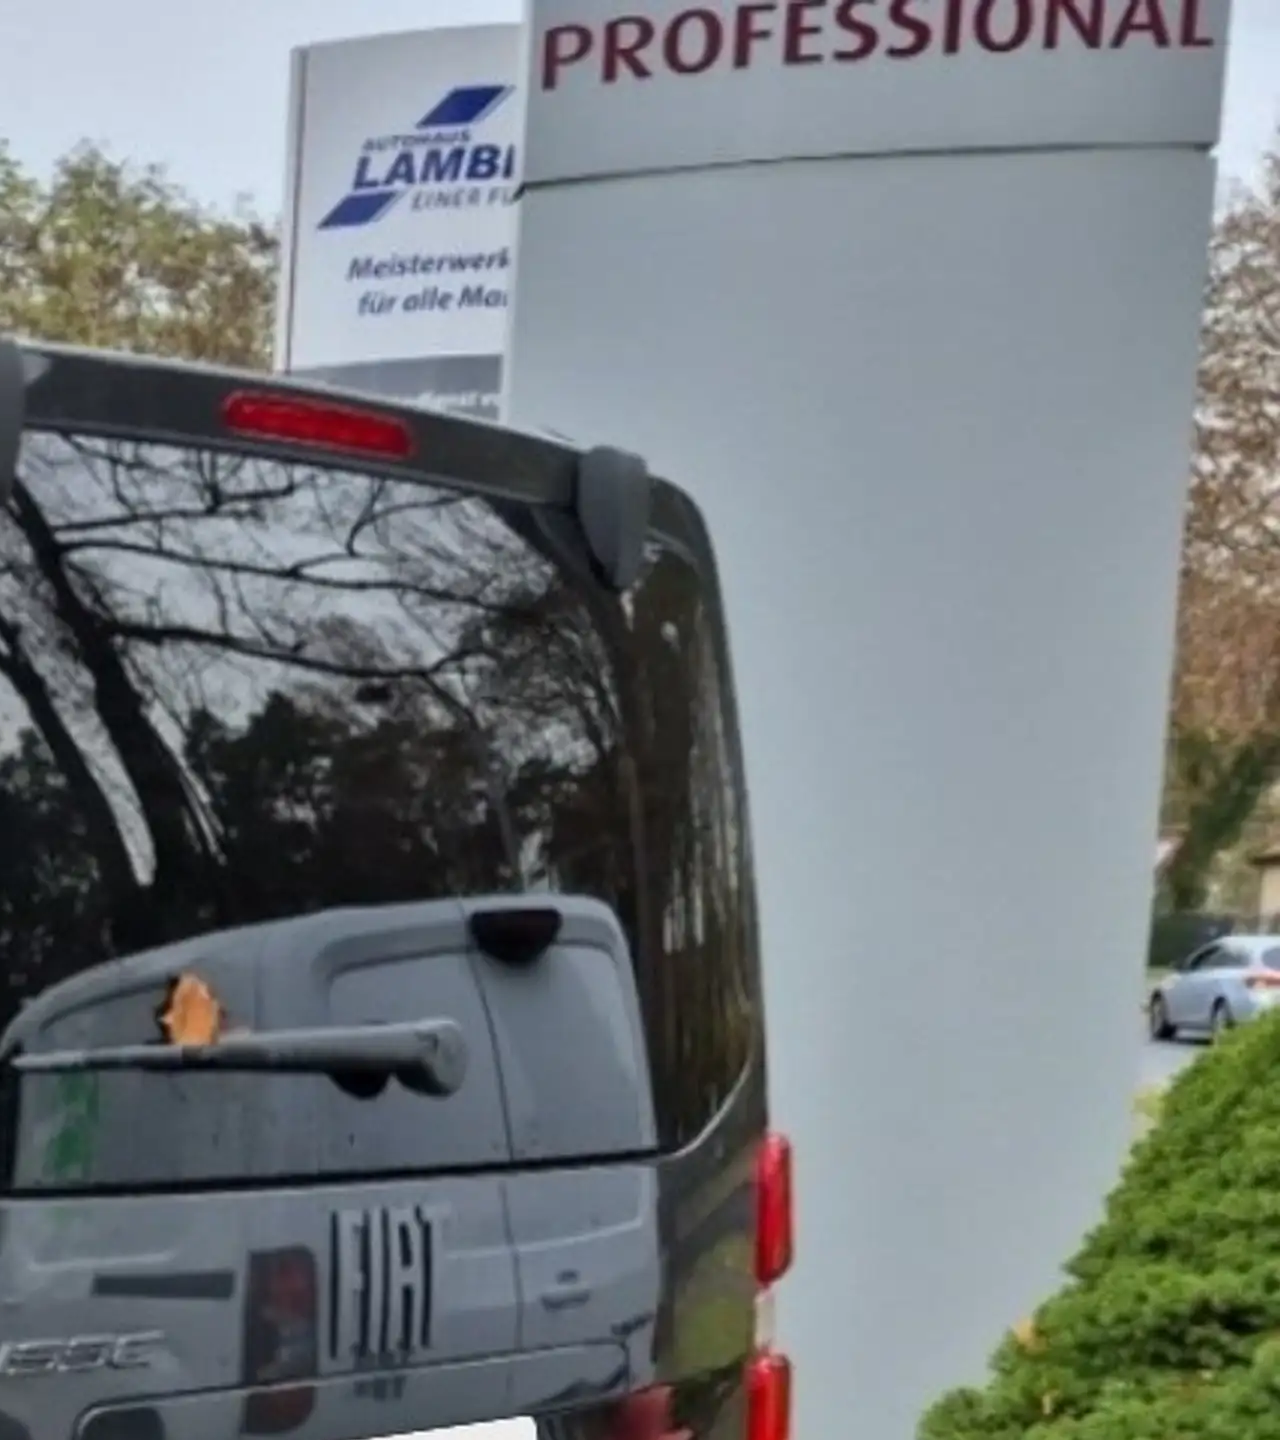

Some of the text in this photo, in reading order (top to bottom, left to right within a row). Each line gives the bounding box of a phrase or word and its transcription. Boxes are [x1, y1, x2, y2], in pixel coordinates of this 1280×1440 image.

[540, 0, 1215, 90] PROFESSIONAL
[362, 129, 472, 151] AUTOHAUS
[357, 291, 400, 316] für
[401, 287, 454, 312] alle
